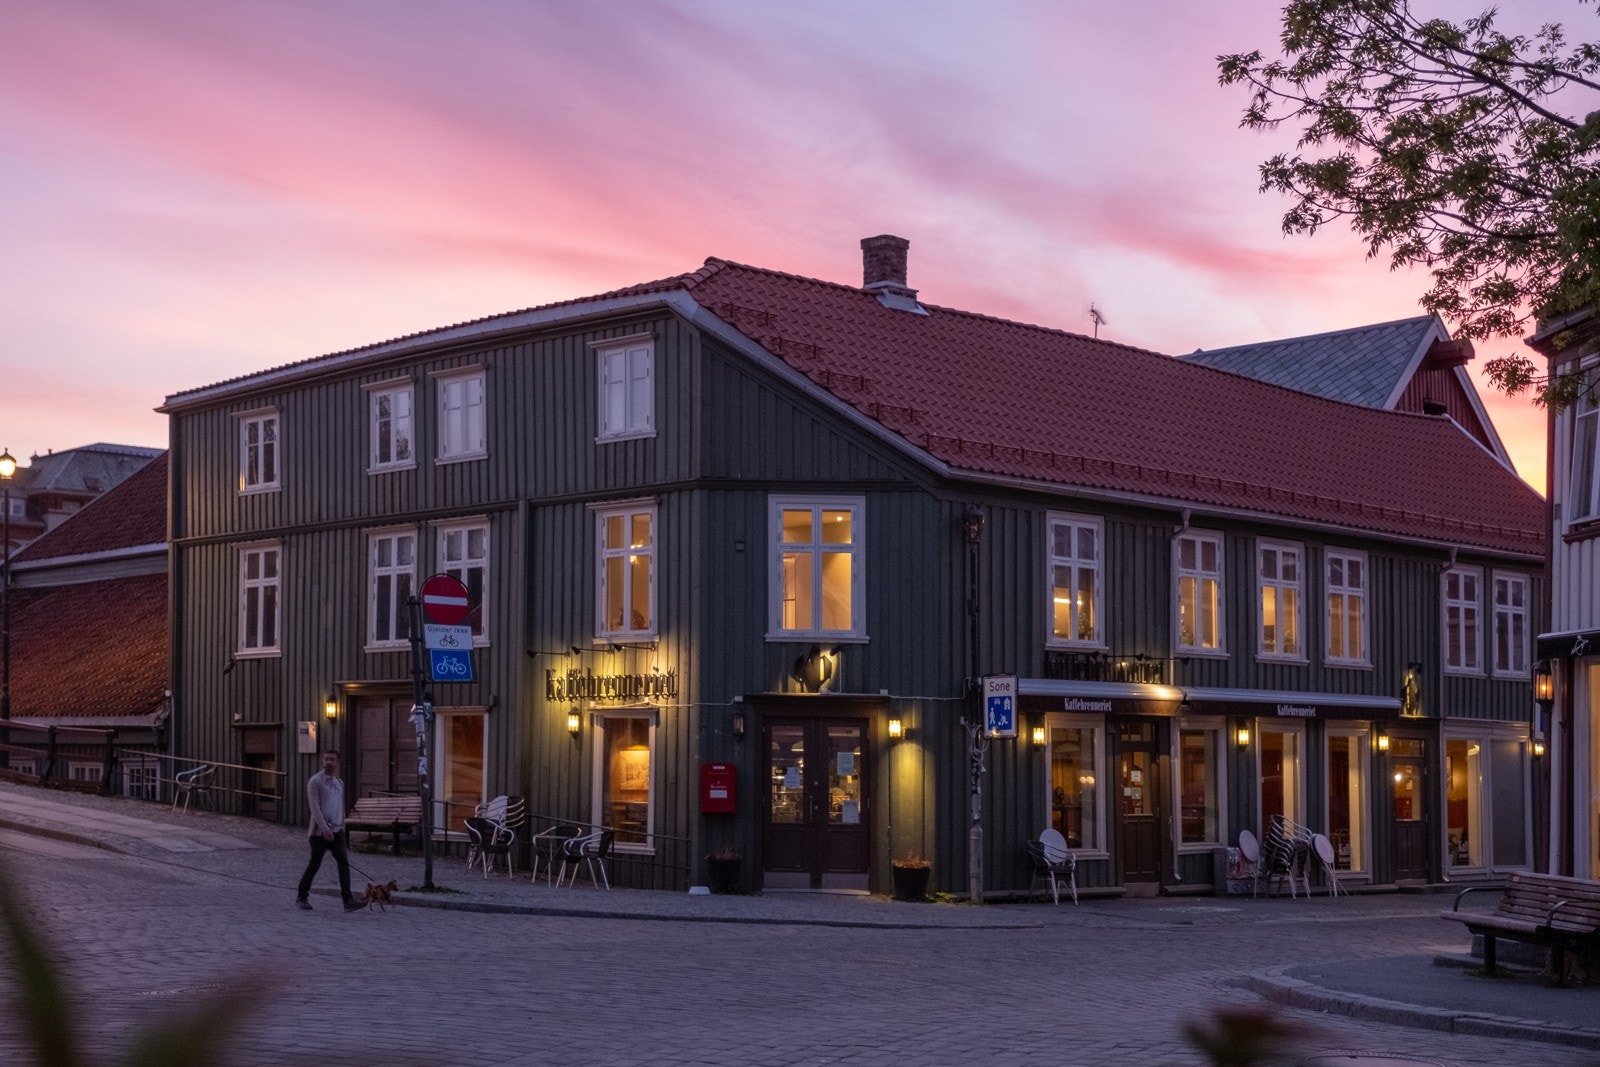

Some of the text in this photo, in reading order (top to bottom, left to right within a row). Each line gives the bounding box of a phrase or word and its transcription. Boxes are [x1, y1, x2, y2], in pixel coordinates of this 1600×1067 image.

[427, 625, 452, 634] Gjelder
[989, 681, 1011, 692] Sone
[1064, 697, 1112, 712] Kaffebrenneriet
[1277, 704, 1316, 717] Kaffebrenneriet
